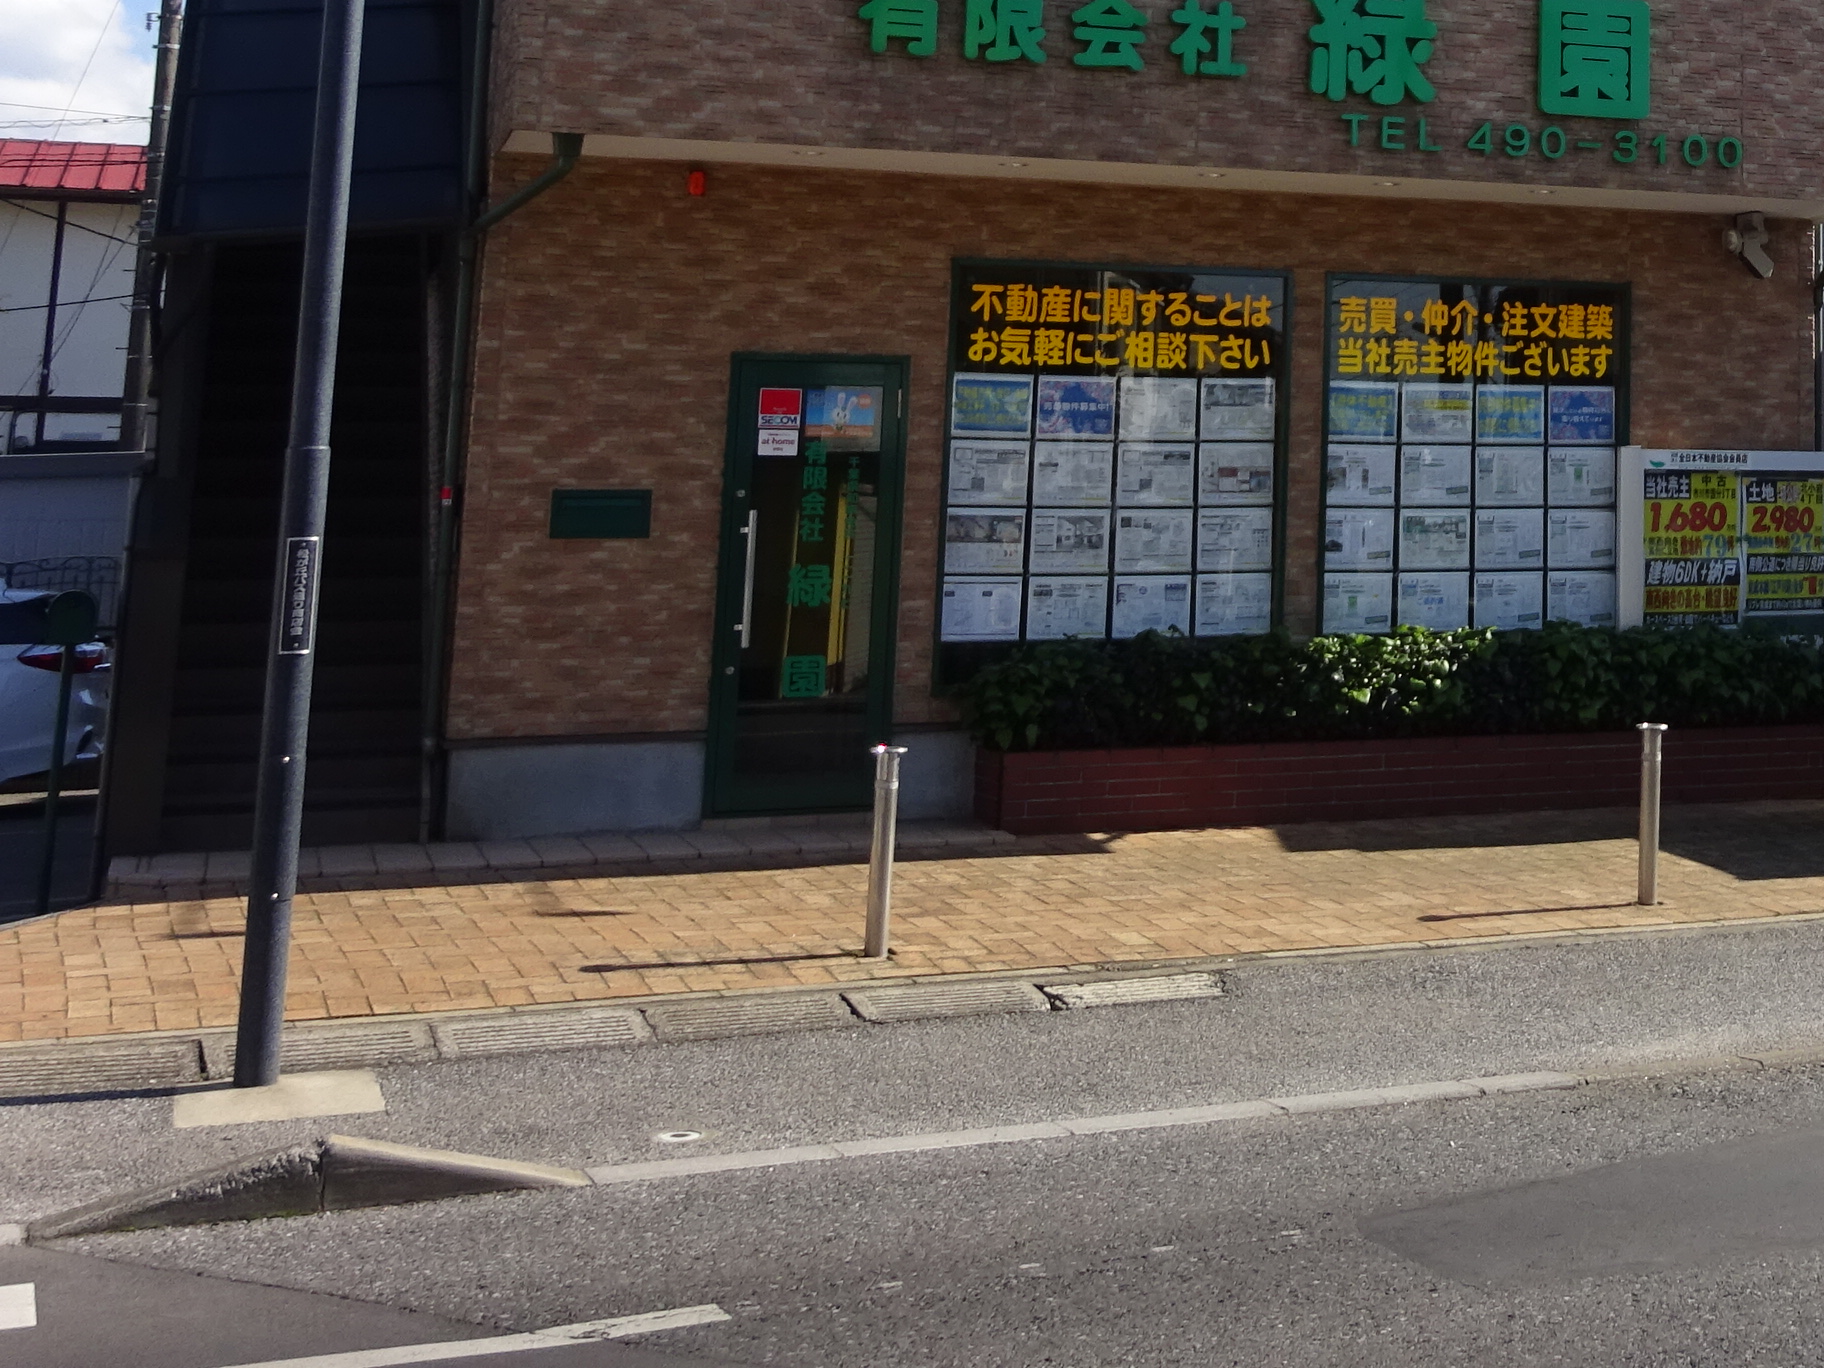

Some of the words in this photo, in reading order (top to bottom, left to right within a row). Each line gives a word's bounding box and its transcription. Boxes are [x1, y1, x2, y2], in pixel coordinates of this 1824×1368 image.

[1342, 112, 1443, 154] TEL
[1468, 122, 1744, 169] 490-3100
[971, 283, 1272, 327] 不動産に関することは
[1338, 296, 1613, 340] 売買・仲介・注文建築
[968, 327, 1271, 370] お気軽にご相談下さい
[1337, 338, 1613, 378] 当社売主物件ございます
[761, 415, 798, 425] SECOM
[761, 437, 770, 445] at
[771, 437, 795, 445] home
[800, 441, 828, 542] 有限会社
[1646, 474, 1689, 498] 当社売主
[1701, 474, 1726, 488] 中古
[1748, 482, 1775, 502] 土地
[1650, 501, 1727, 532] 1,680
[1752, 505, 1814, 533] 2,980
[781, 563, 832, 698] 緑園
